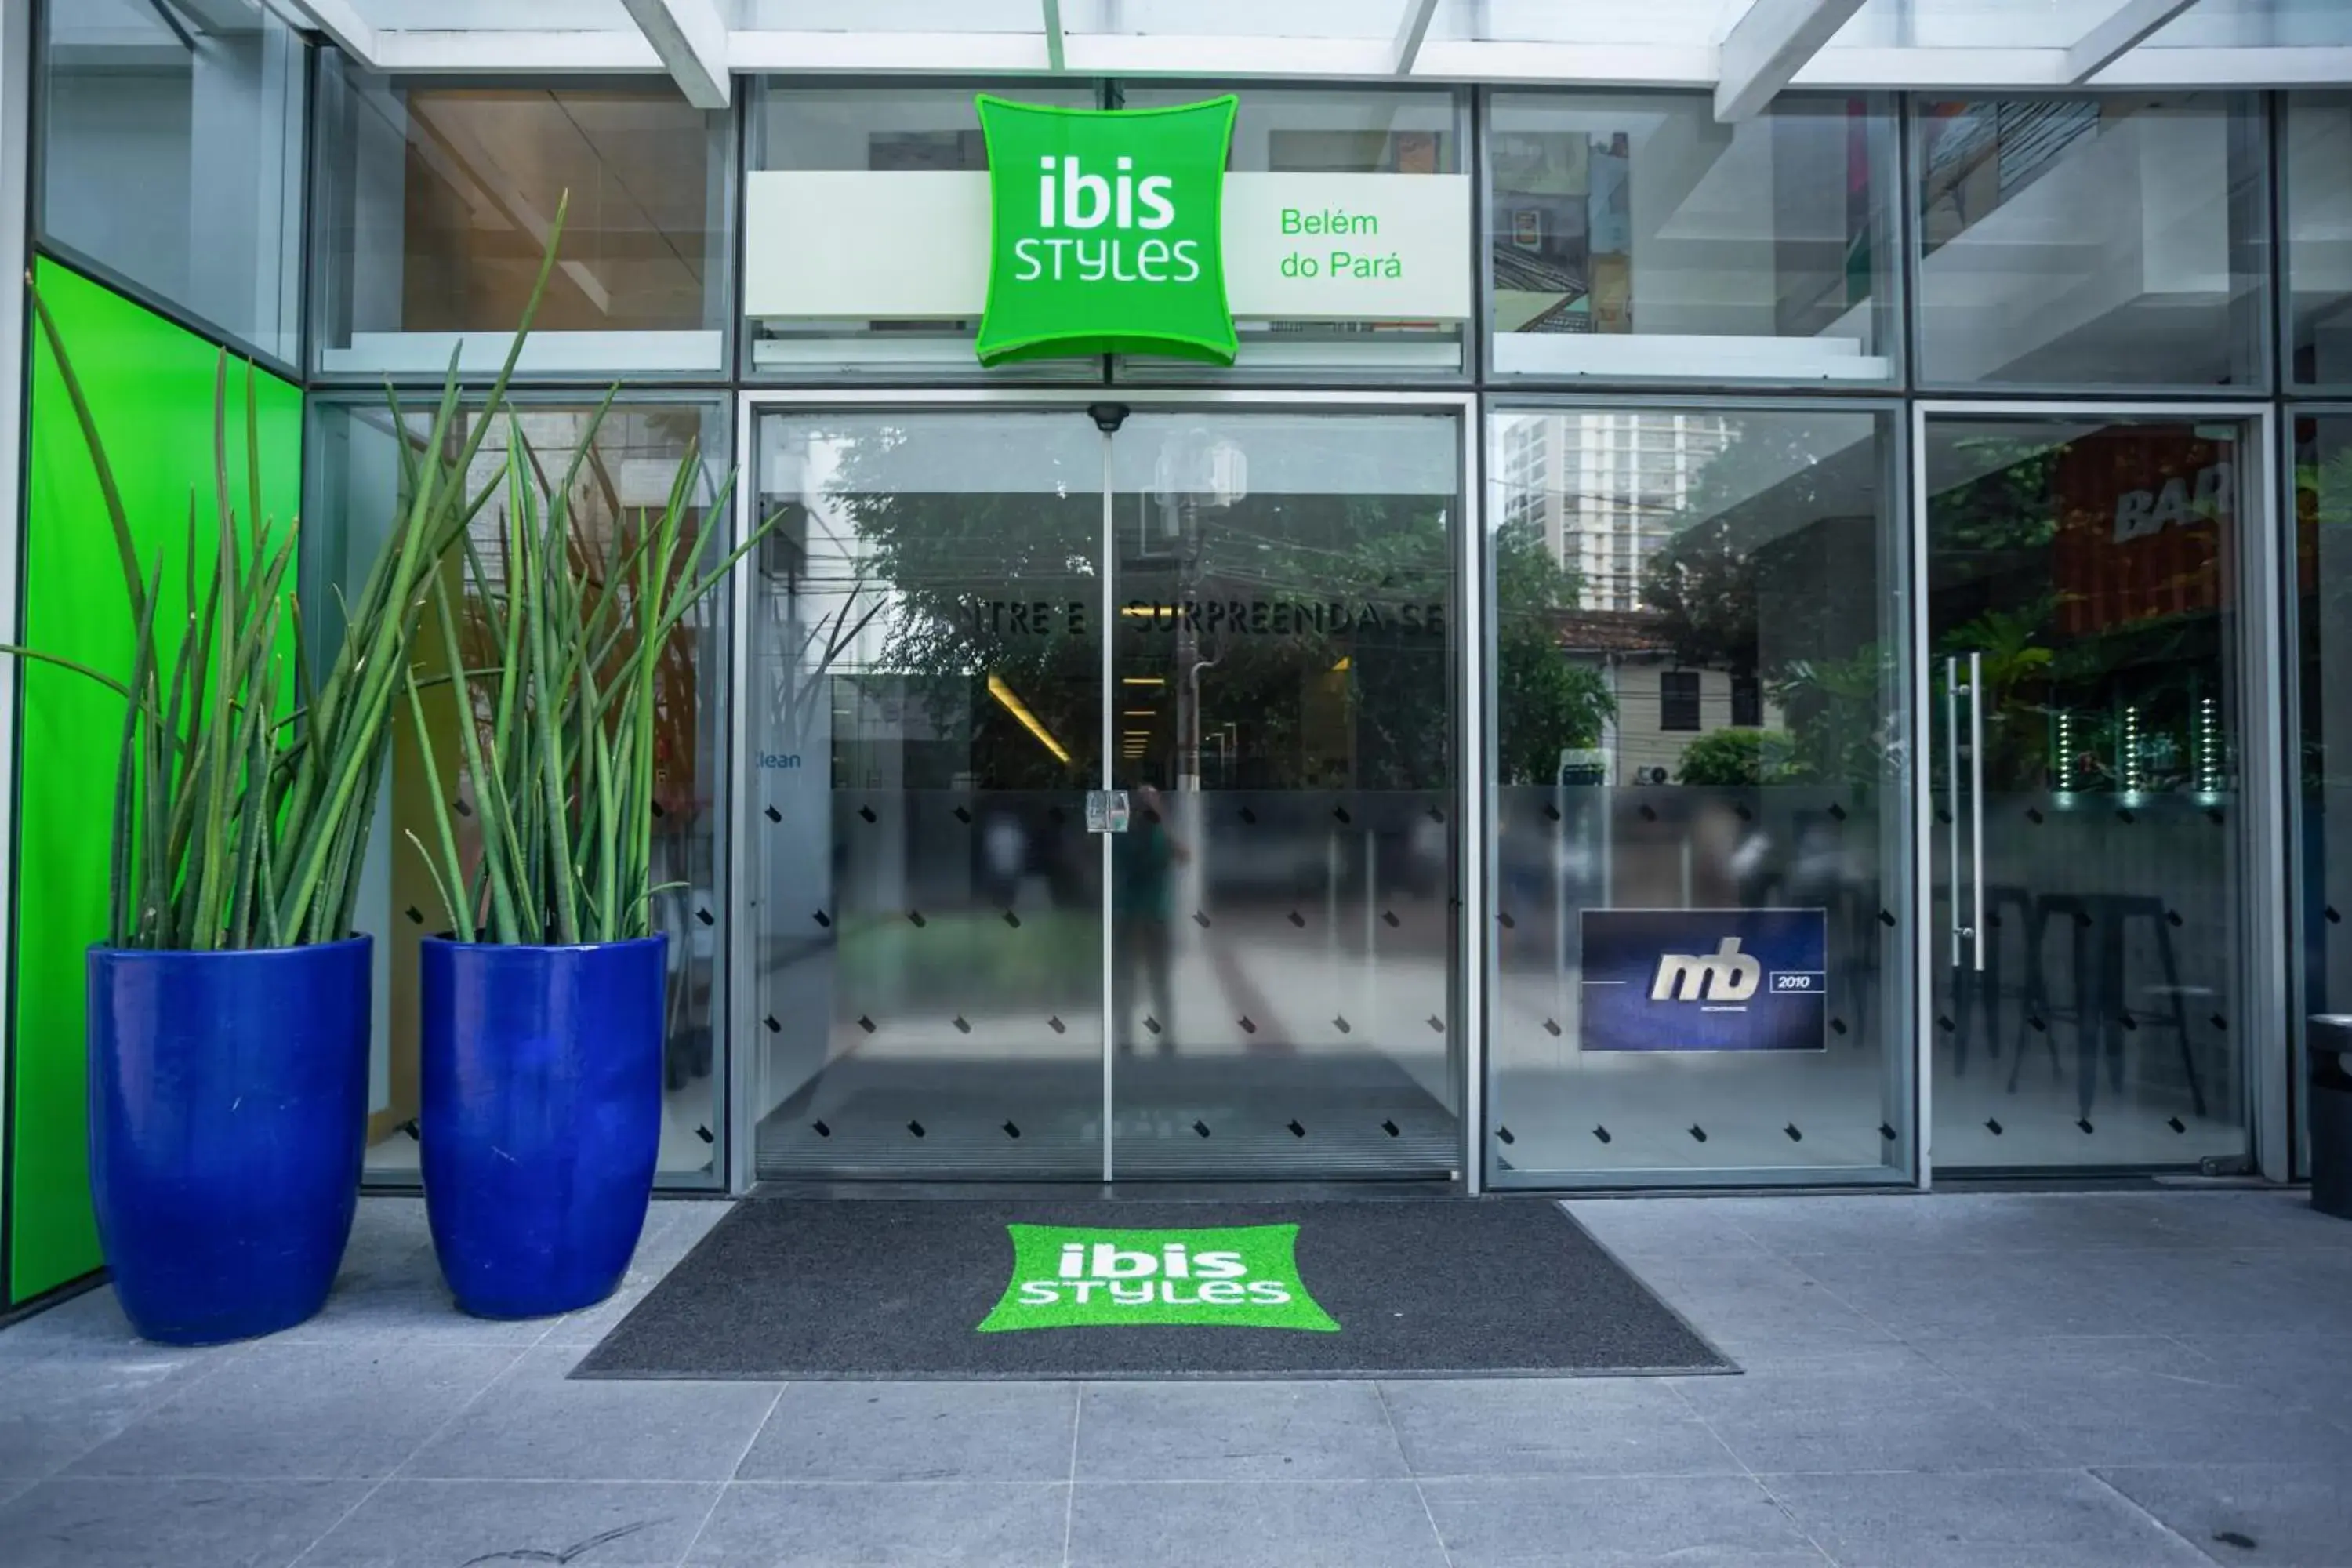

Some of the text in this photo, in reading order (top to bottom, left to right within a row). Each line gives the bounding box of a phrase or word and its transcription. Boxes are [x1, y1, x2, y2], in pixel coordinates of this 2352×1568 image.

[1040, 155, 1174, 230] ibis
[1281, 209, 1377, 234] Belém
[1281, 252, 1401, 278] do Pará
[2112, 462, 2234, 544] BAR
[1778, 976, 1810, 988] 2010
[1058, 1243, 1248, 1279] ibis
